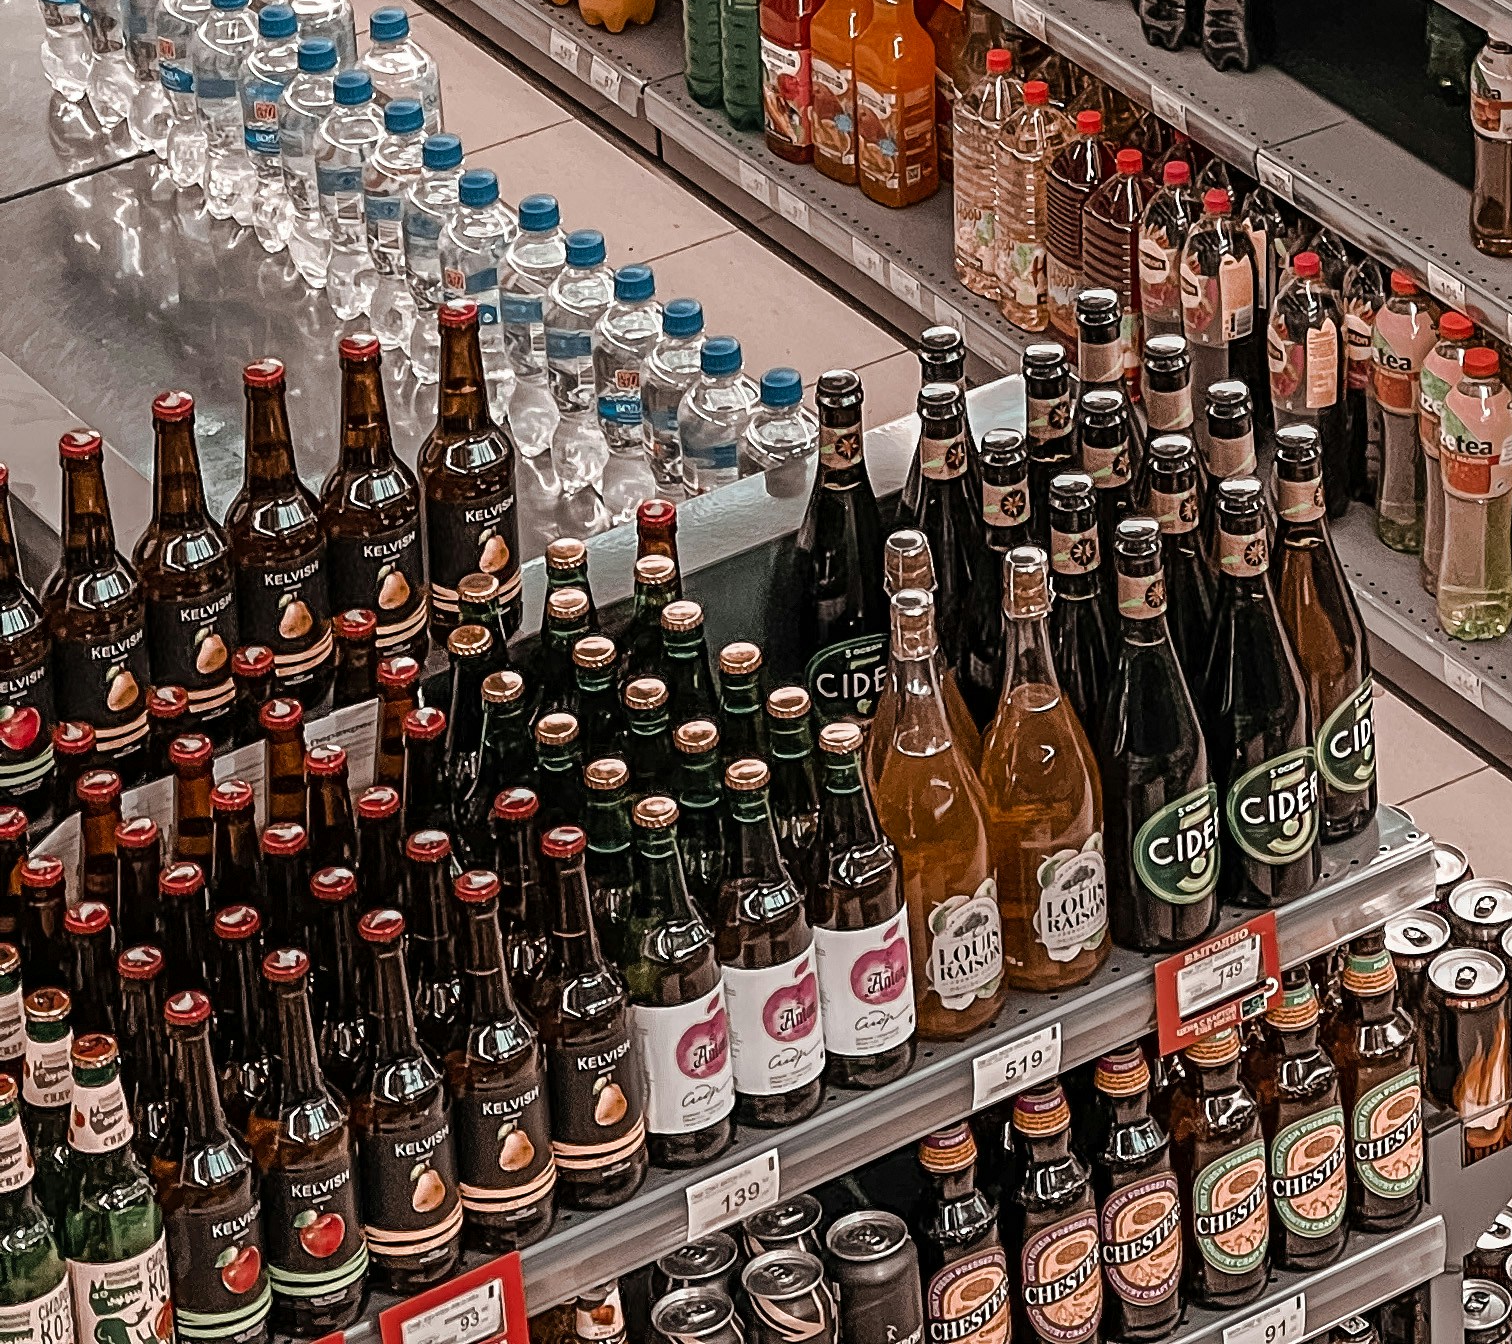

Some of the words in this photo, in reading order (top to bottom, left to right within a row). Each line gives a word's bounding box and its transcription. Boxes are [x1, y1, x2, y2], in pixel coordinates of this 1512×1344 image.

[264, 560, 320, 587] KELVISH
[817, 668, 888, 700] CIDE
[1329, 719, 1376, 758] CID
[1184, 928, 1249, 966] ВЫГОДНО
[577, 1039, 632, 1072] KELVISH
[1003, 1049, 1045, 1081] 519
[482, 1087, 540, 1117] KELVISH
[394, 1125, 450, 1159] KELVISH
[291, 1170, 351, 1198] KELVISH
[720, 1182, 762, 1219] 139
[459, 1312, 480, 1332] 93
